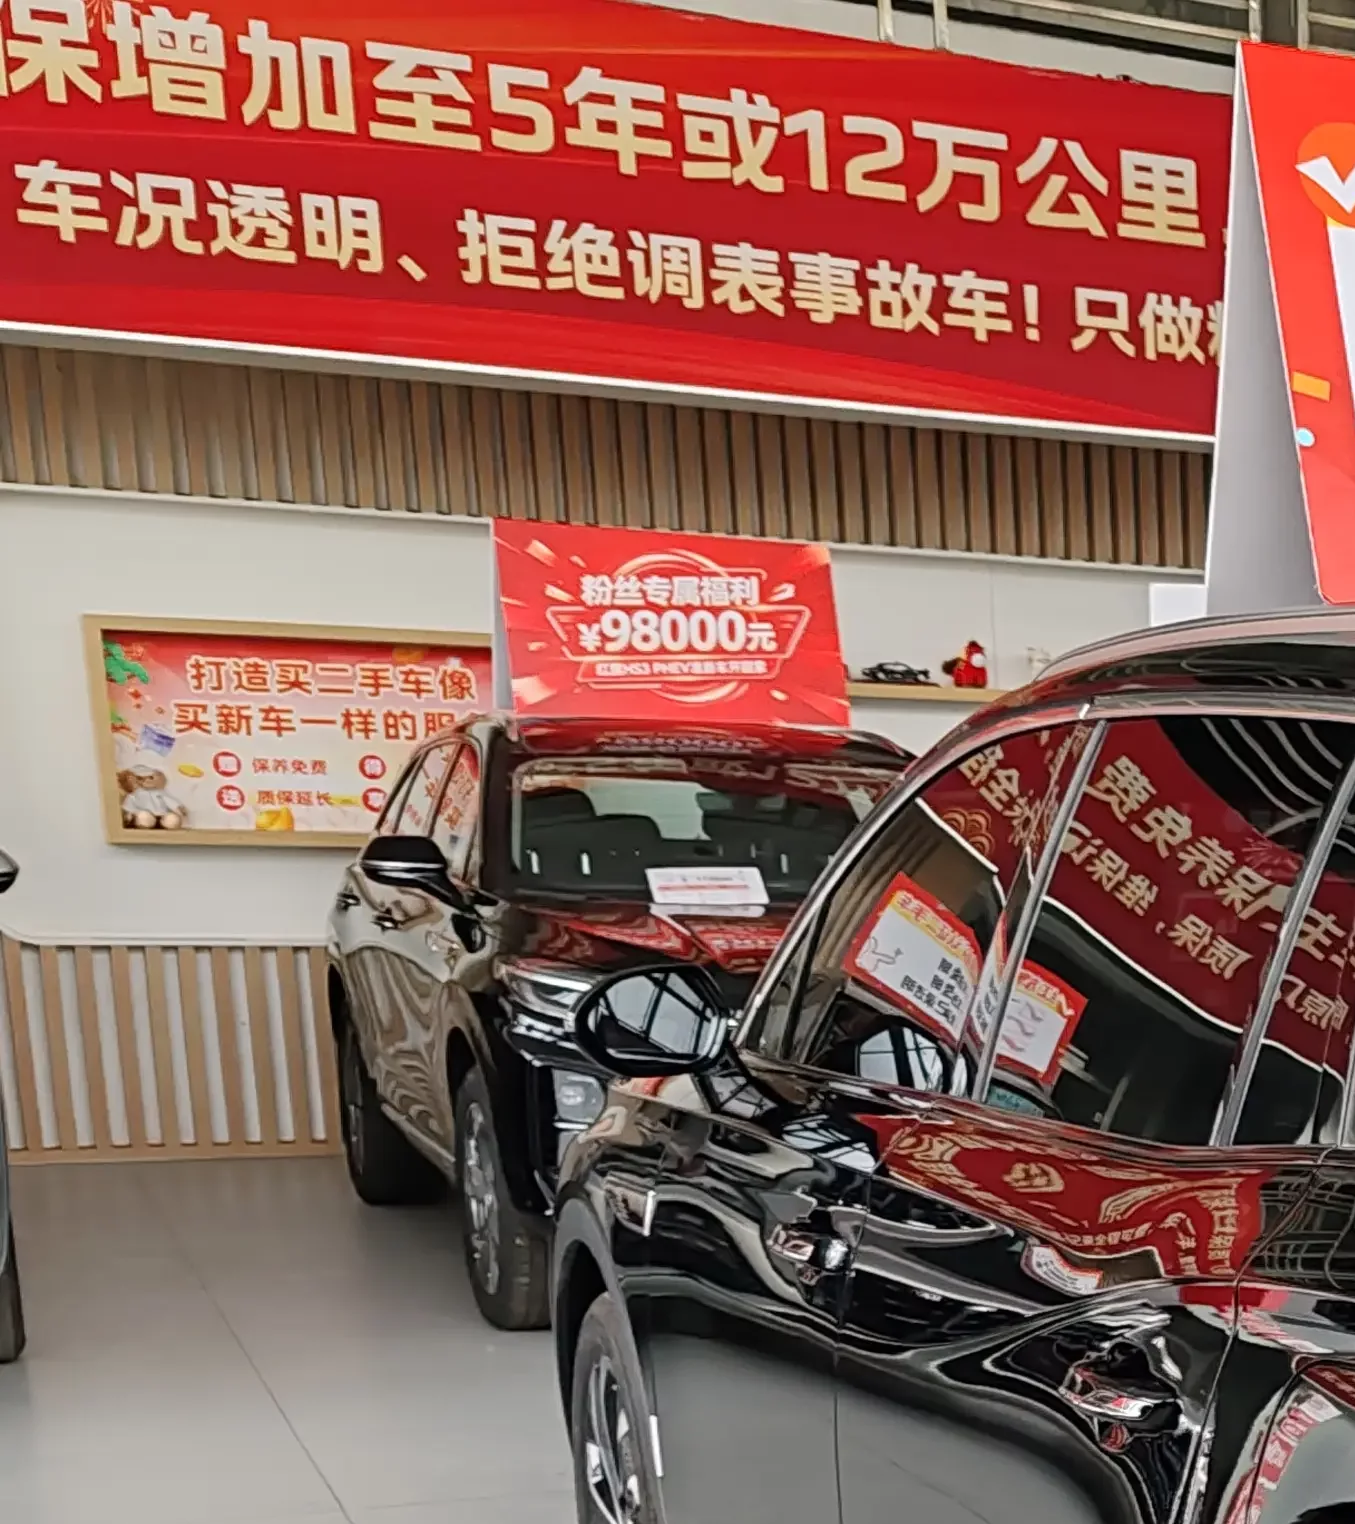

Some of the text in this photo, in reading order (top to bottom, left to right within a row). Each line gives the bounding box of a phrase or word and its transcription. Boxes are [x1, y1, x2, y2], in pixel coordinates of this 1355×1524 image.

[580, 575, 760, 607] 粉丝专属福利
[187, 656, 477, 701] 打造买二手车像
